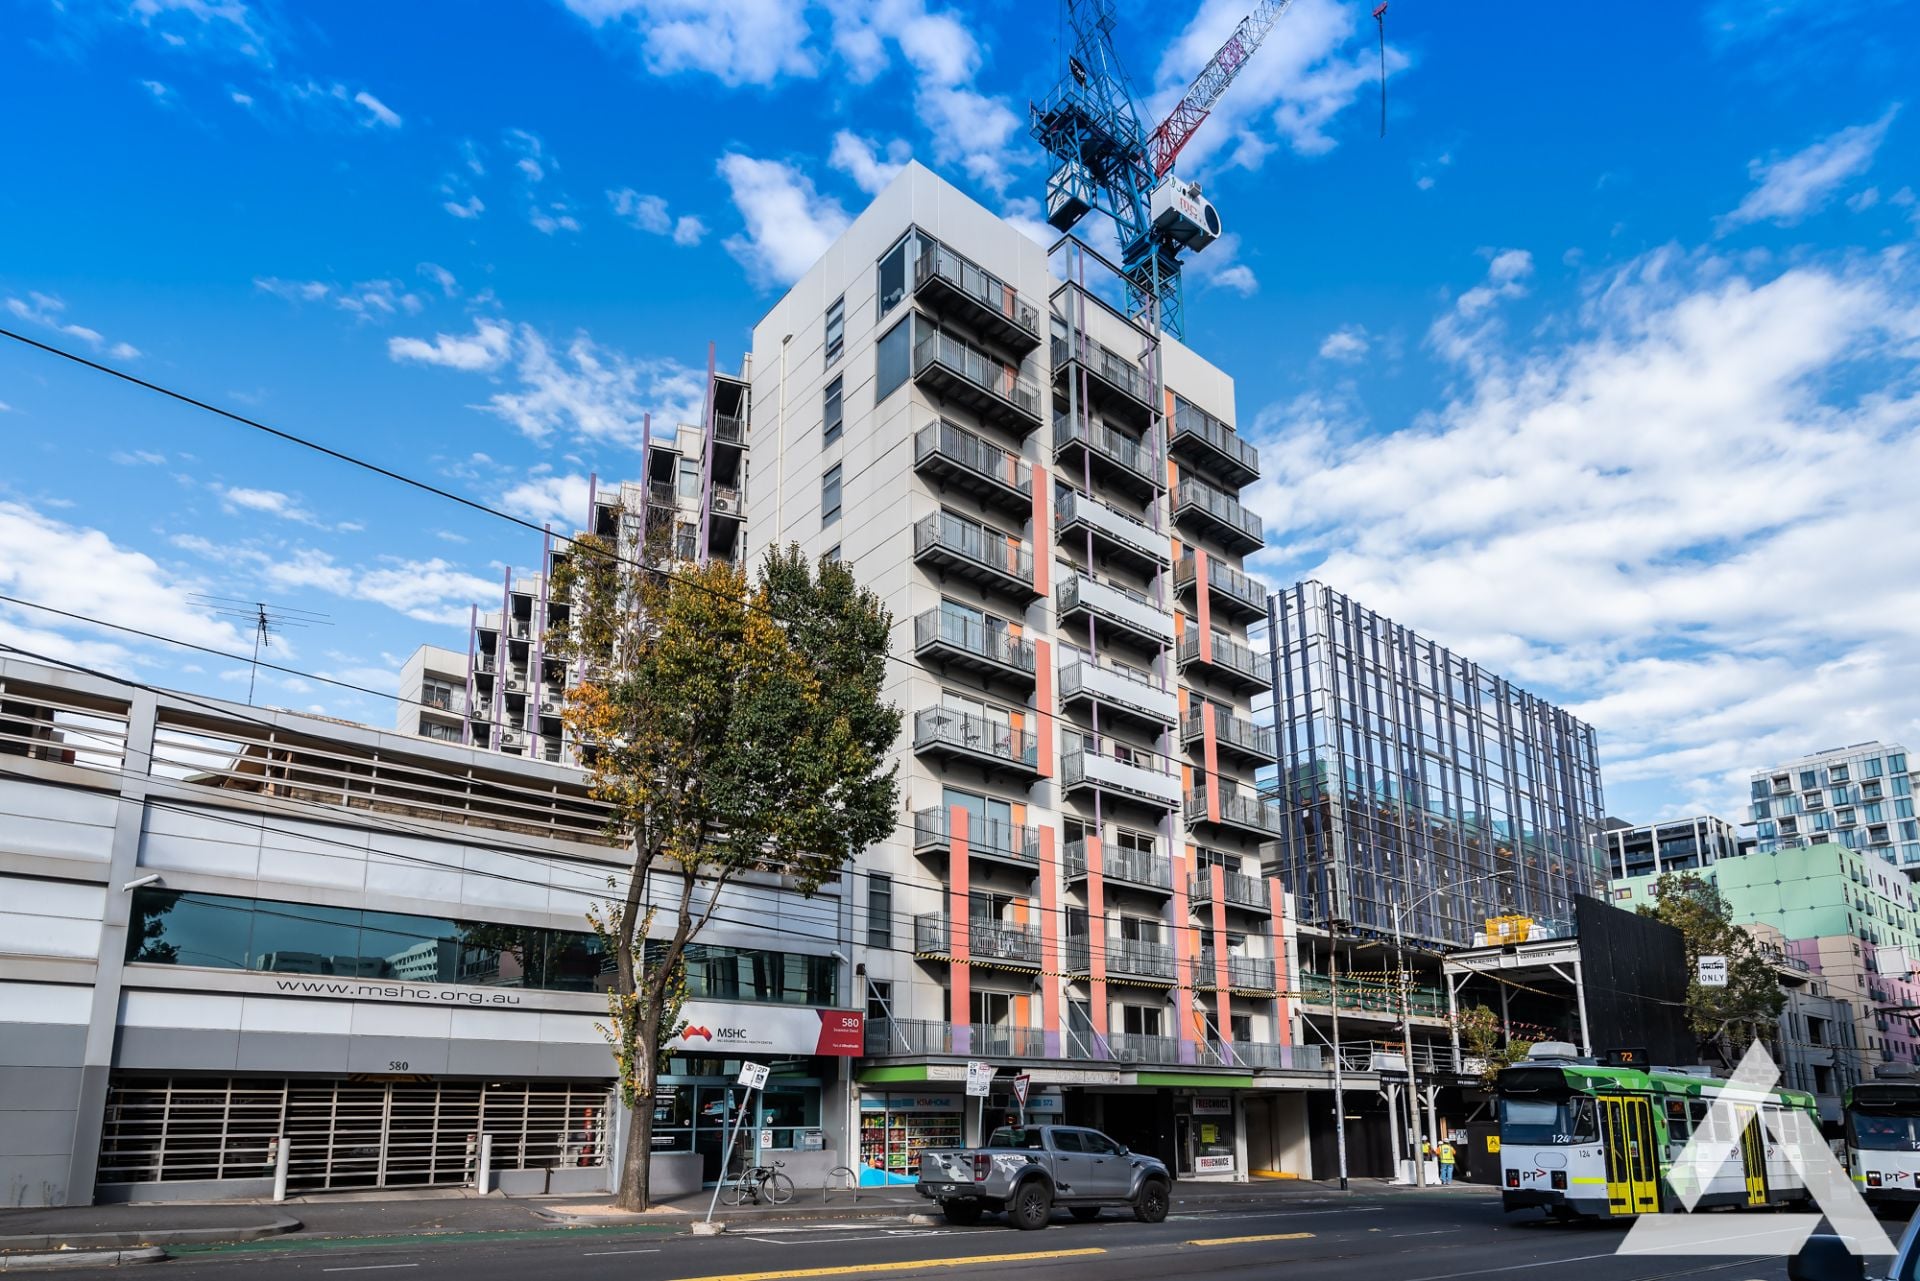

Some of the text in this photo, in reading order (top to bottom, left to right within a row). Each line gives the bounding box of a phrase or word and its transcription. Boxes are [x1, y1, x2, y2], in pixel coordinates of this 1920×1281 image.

[1701, 974, 1724, 982] ONLY
[276, 980, 520, 1004] www.mshc.org.au
[842, 1017, 859, 1028] 580
[717, 1027, 747, 1039] MSHC
[1621, 1052, 1633, 1062] 72
[388, 1061, 409, 1071] 580
[757, 1066, 768, 1074] 2P
[1552, 1134, 1569, 1143] 124
[1578, 1150, 1590, 1158] 124
